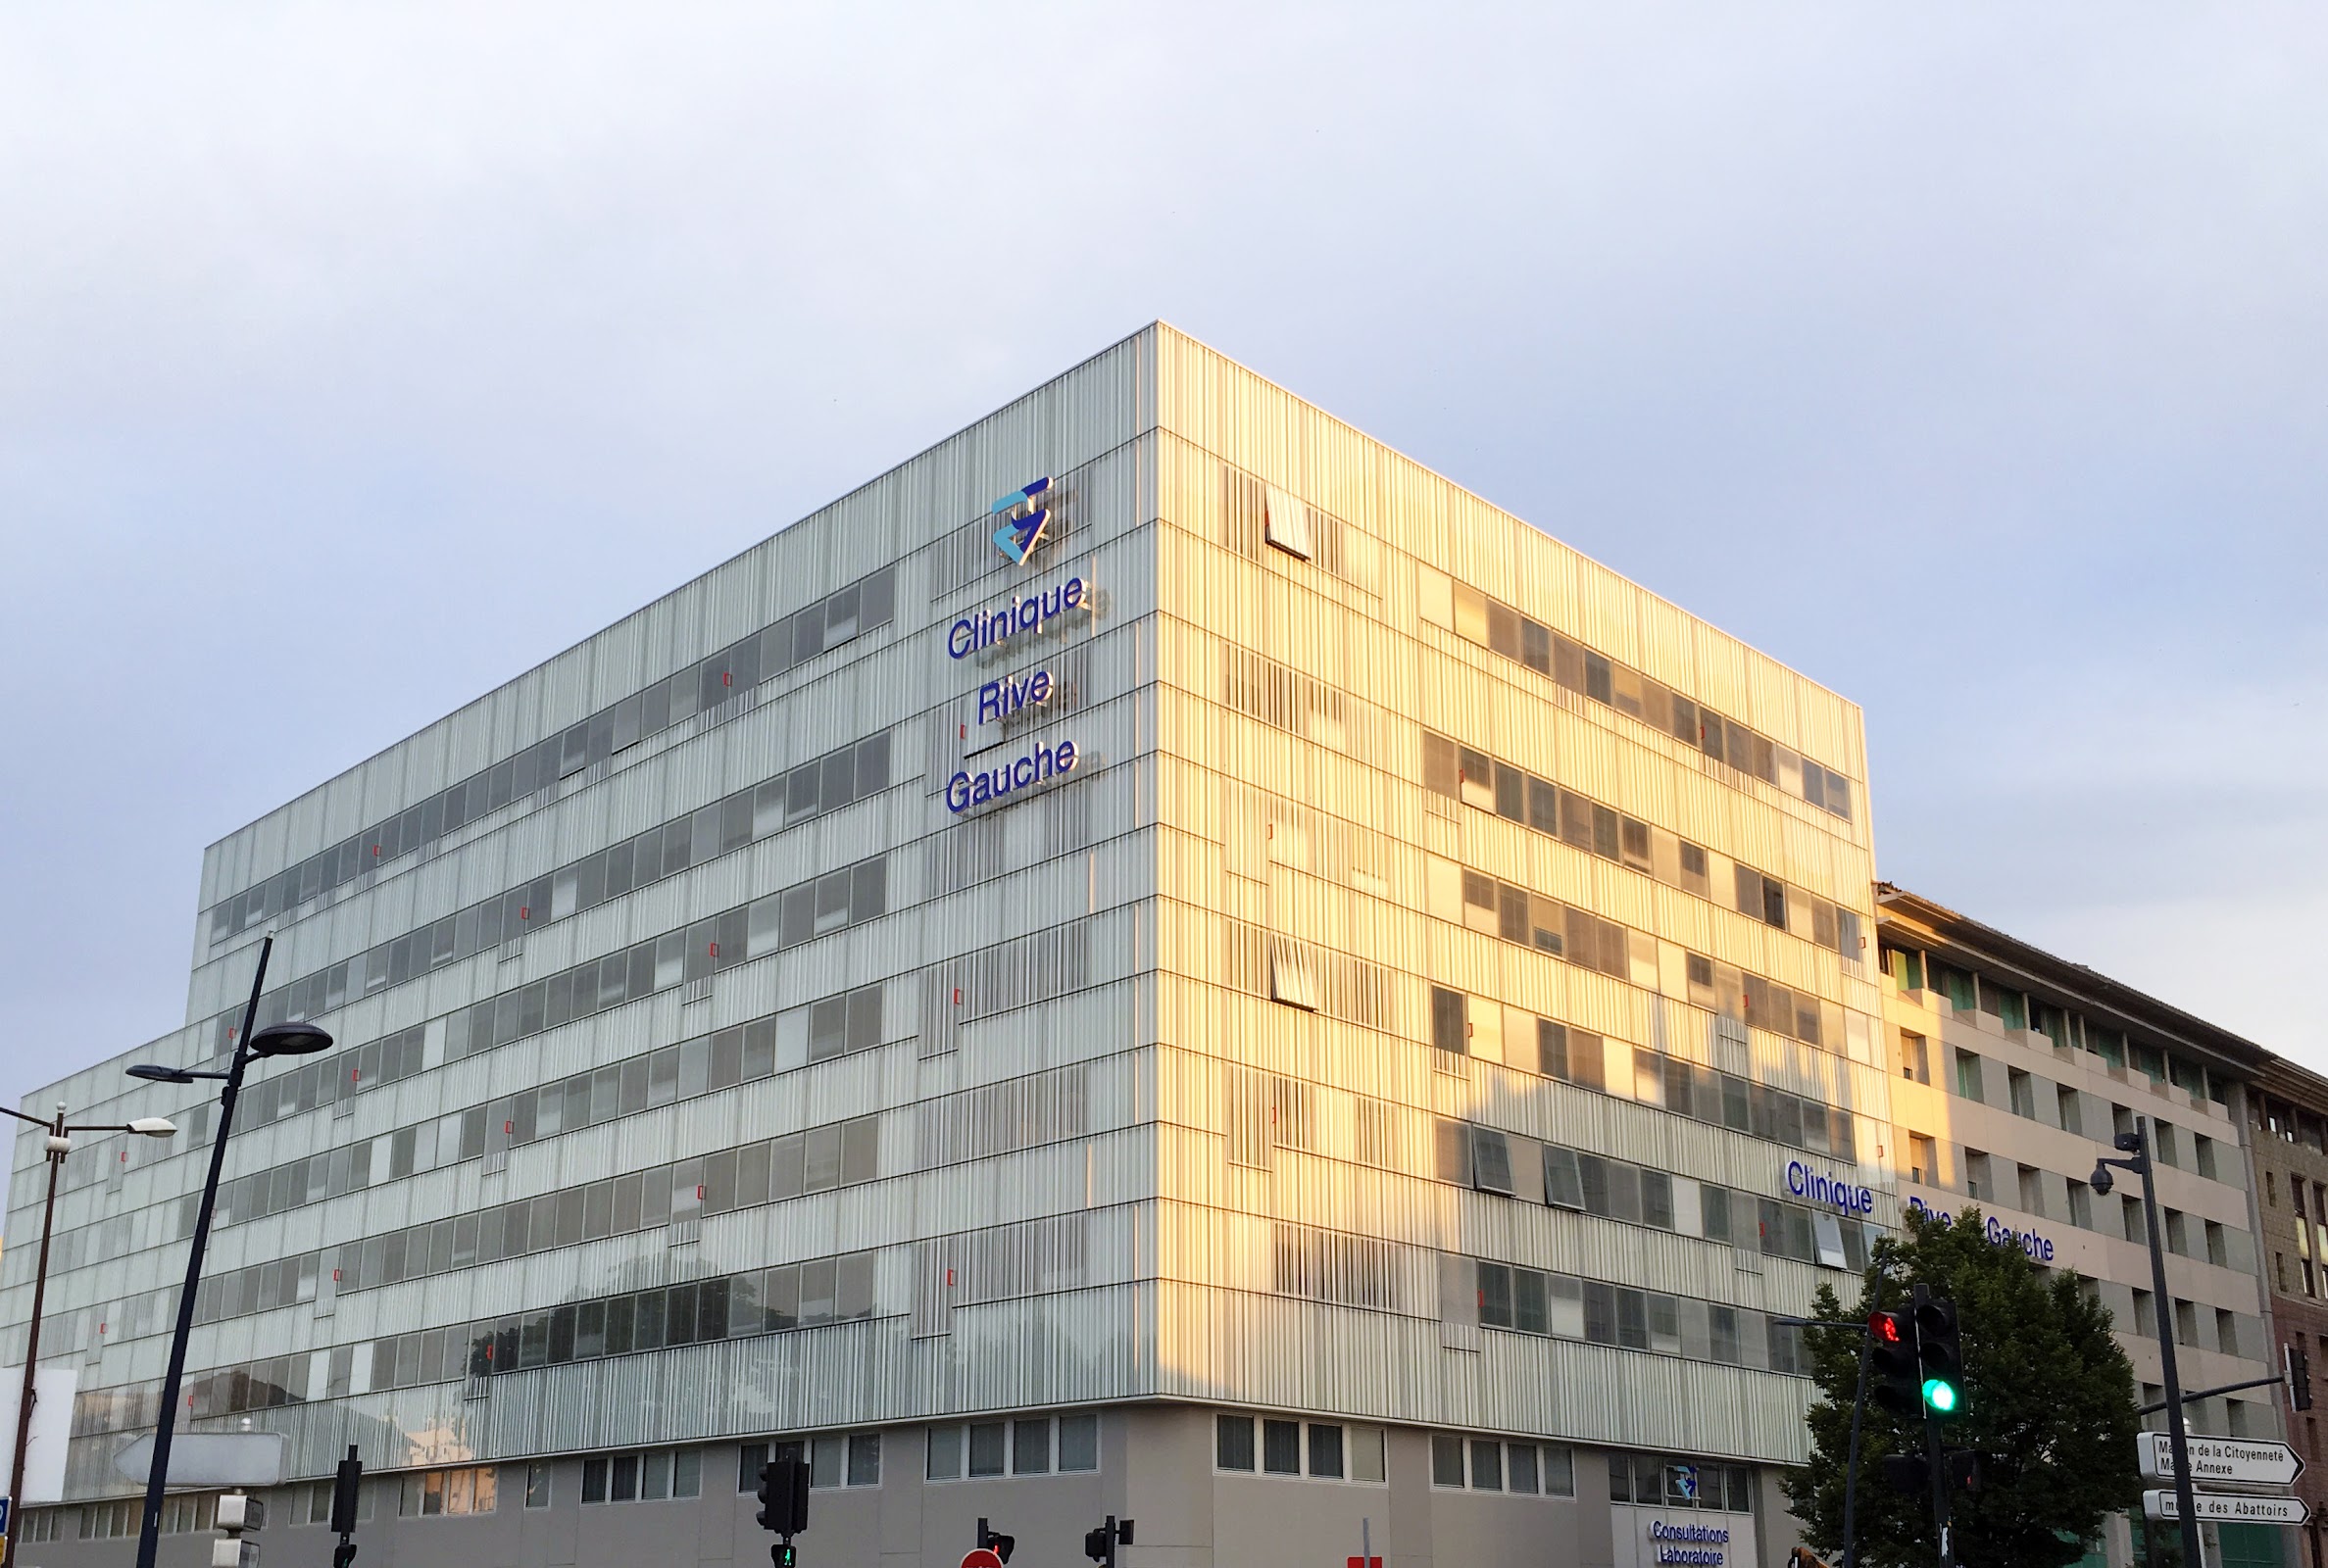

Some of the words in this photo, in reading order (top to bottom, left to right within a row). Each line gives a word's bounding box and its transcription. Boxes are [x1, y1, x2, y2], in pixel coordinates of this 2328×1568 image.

[948, 577, 1087, 660] Clinique
[978, 670, 1053, 725] Rive
[946, 741, 1078, 813] Gauche
[1787, 1160, 1872, 1216] Clinique
[2158, 1441, 2195, 1455] Man
[2198, 1444, 2209, 1457] de
[2212, 1445, 2222, 1457] la
[2224, 1446, 2284, 1462] Citoyenneté
[2160, 1457, 2193, 1472] Mae
[2196, 1460, 2233, 1475] Annexe
[2208, 1500, 2228, 1514] des
[2235, 1501, 2288, 1517] Abattoirs
[1653, 1520, 1729, 1544] Consultations
[1659, 1544, 1723, 1565] Laboratoire
